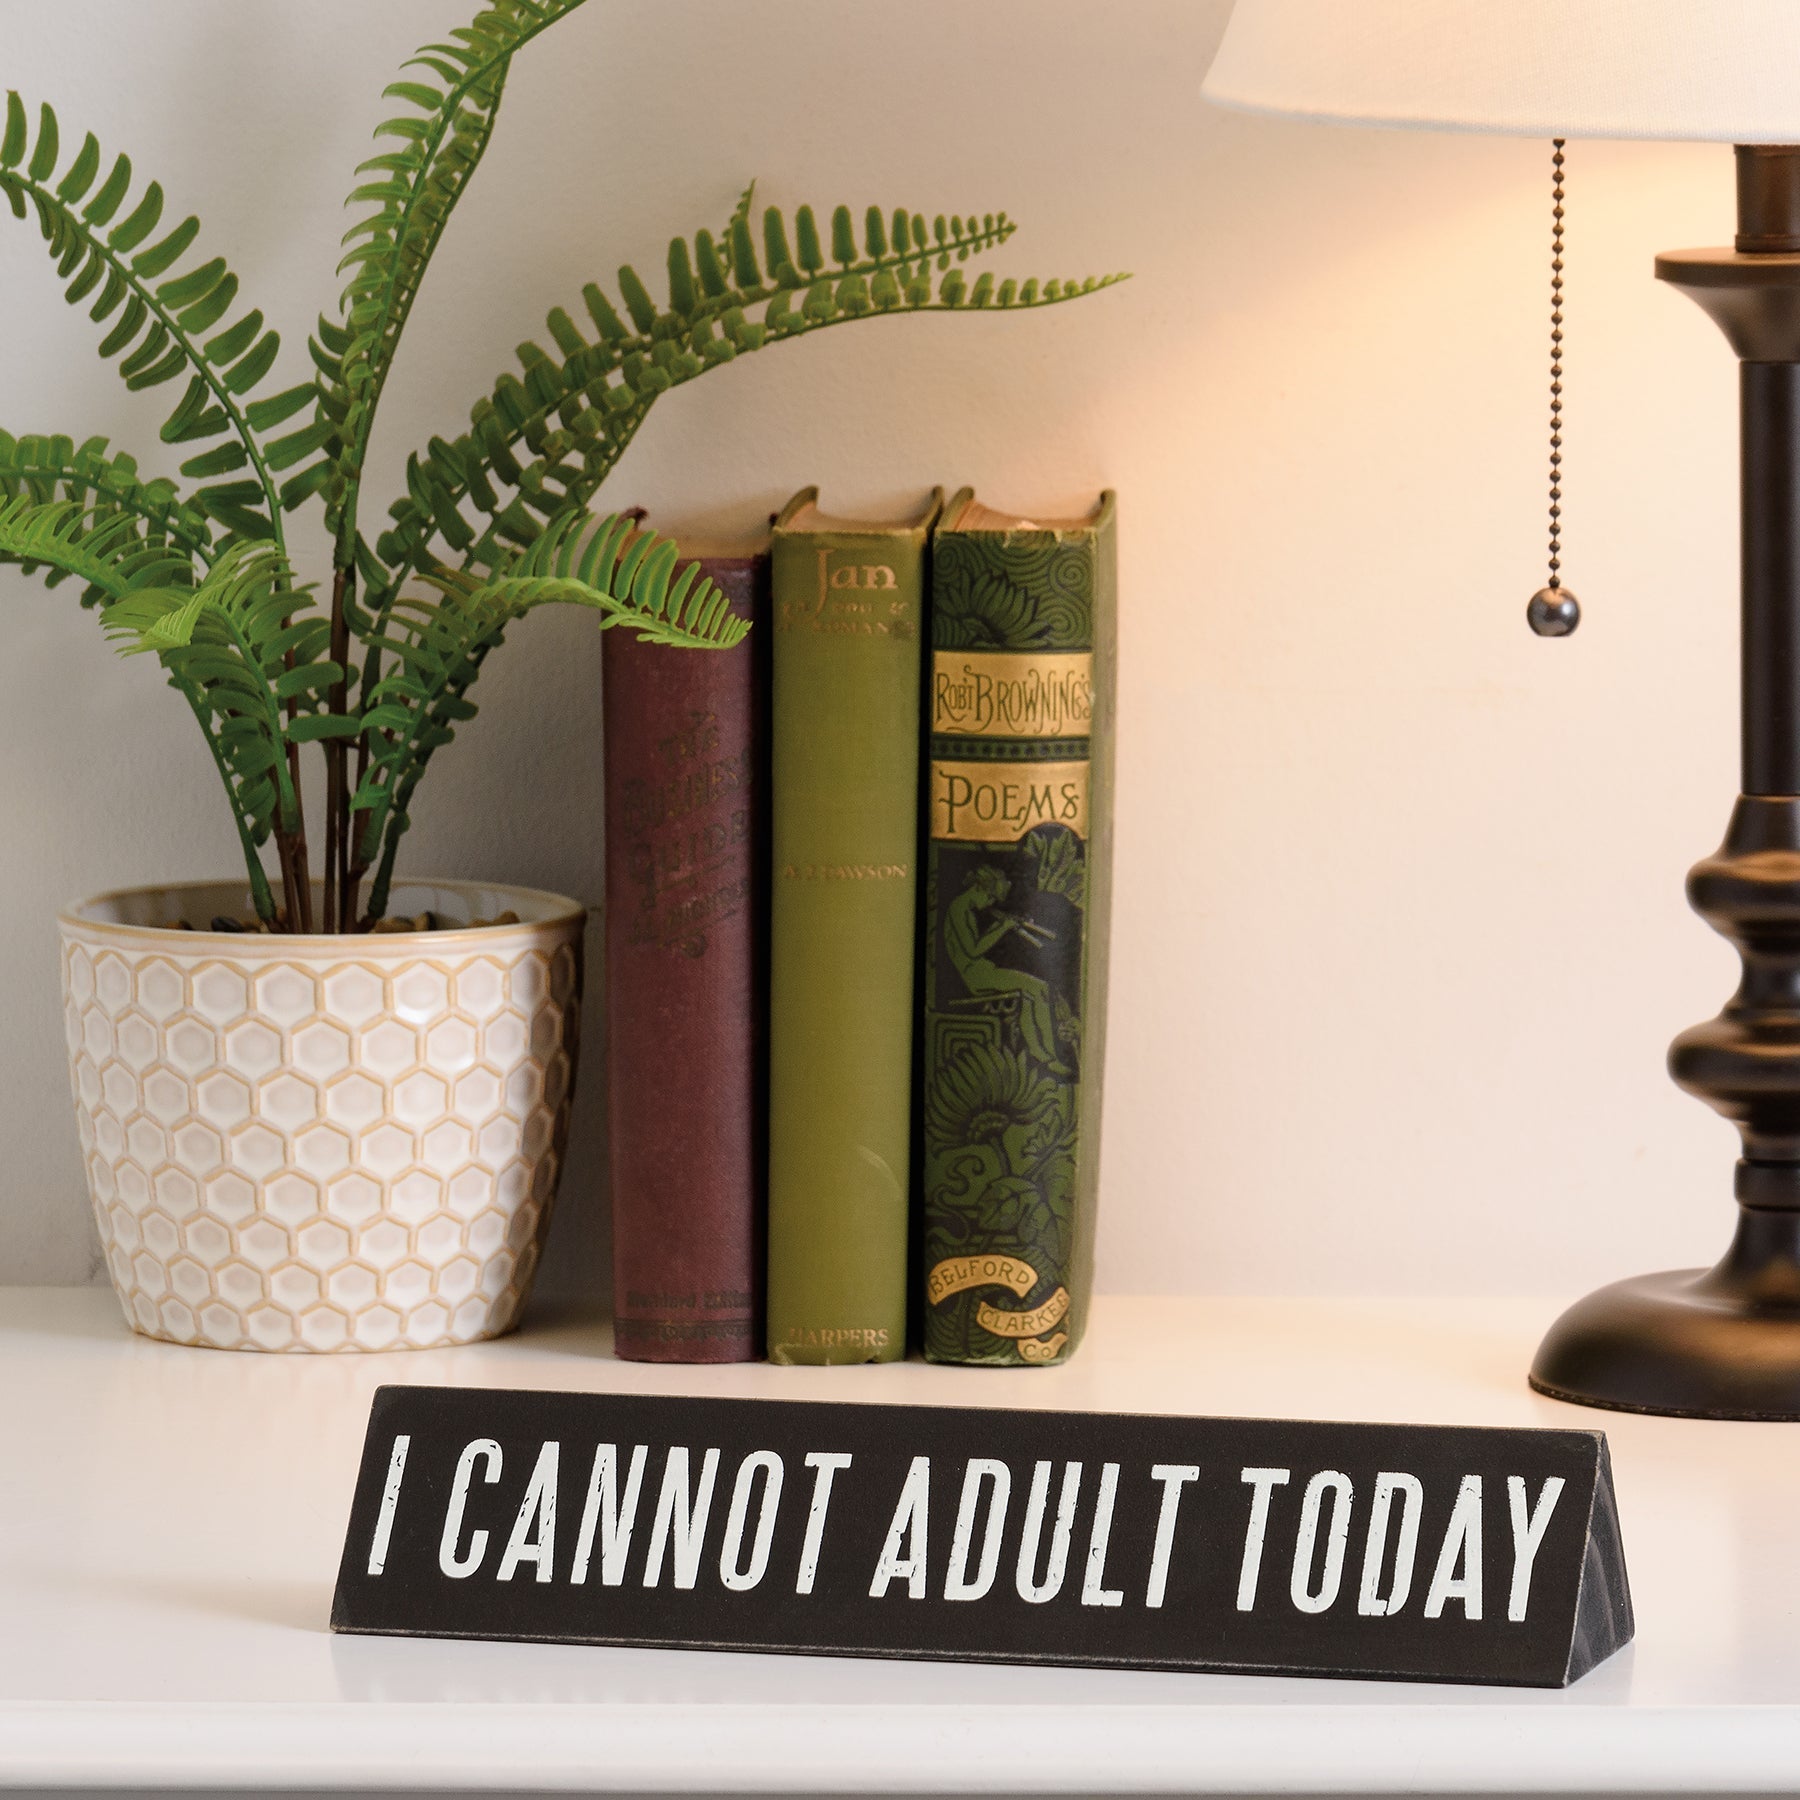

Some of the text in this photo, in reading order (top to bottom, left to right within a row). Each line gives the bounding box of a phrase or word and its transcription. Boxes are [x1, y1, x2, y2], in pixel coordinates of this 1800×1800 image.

[815, 548, 898, 616] Jan
[938, 769, 1080, 834] POEMS
[929, 1260, 1031, 1296] BELFORD
[788, 1327, 889, 1347] HARPERS
[367, 1435, 1566, 1622] I CANNOT ADULT TODAY
